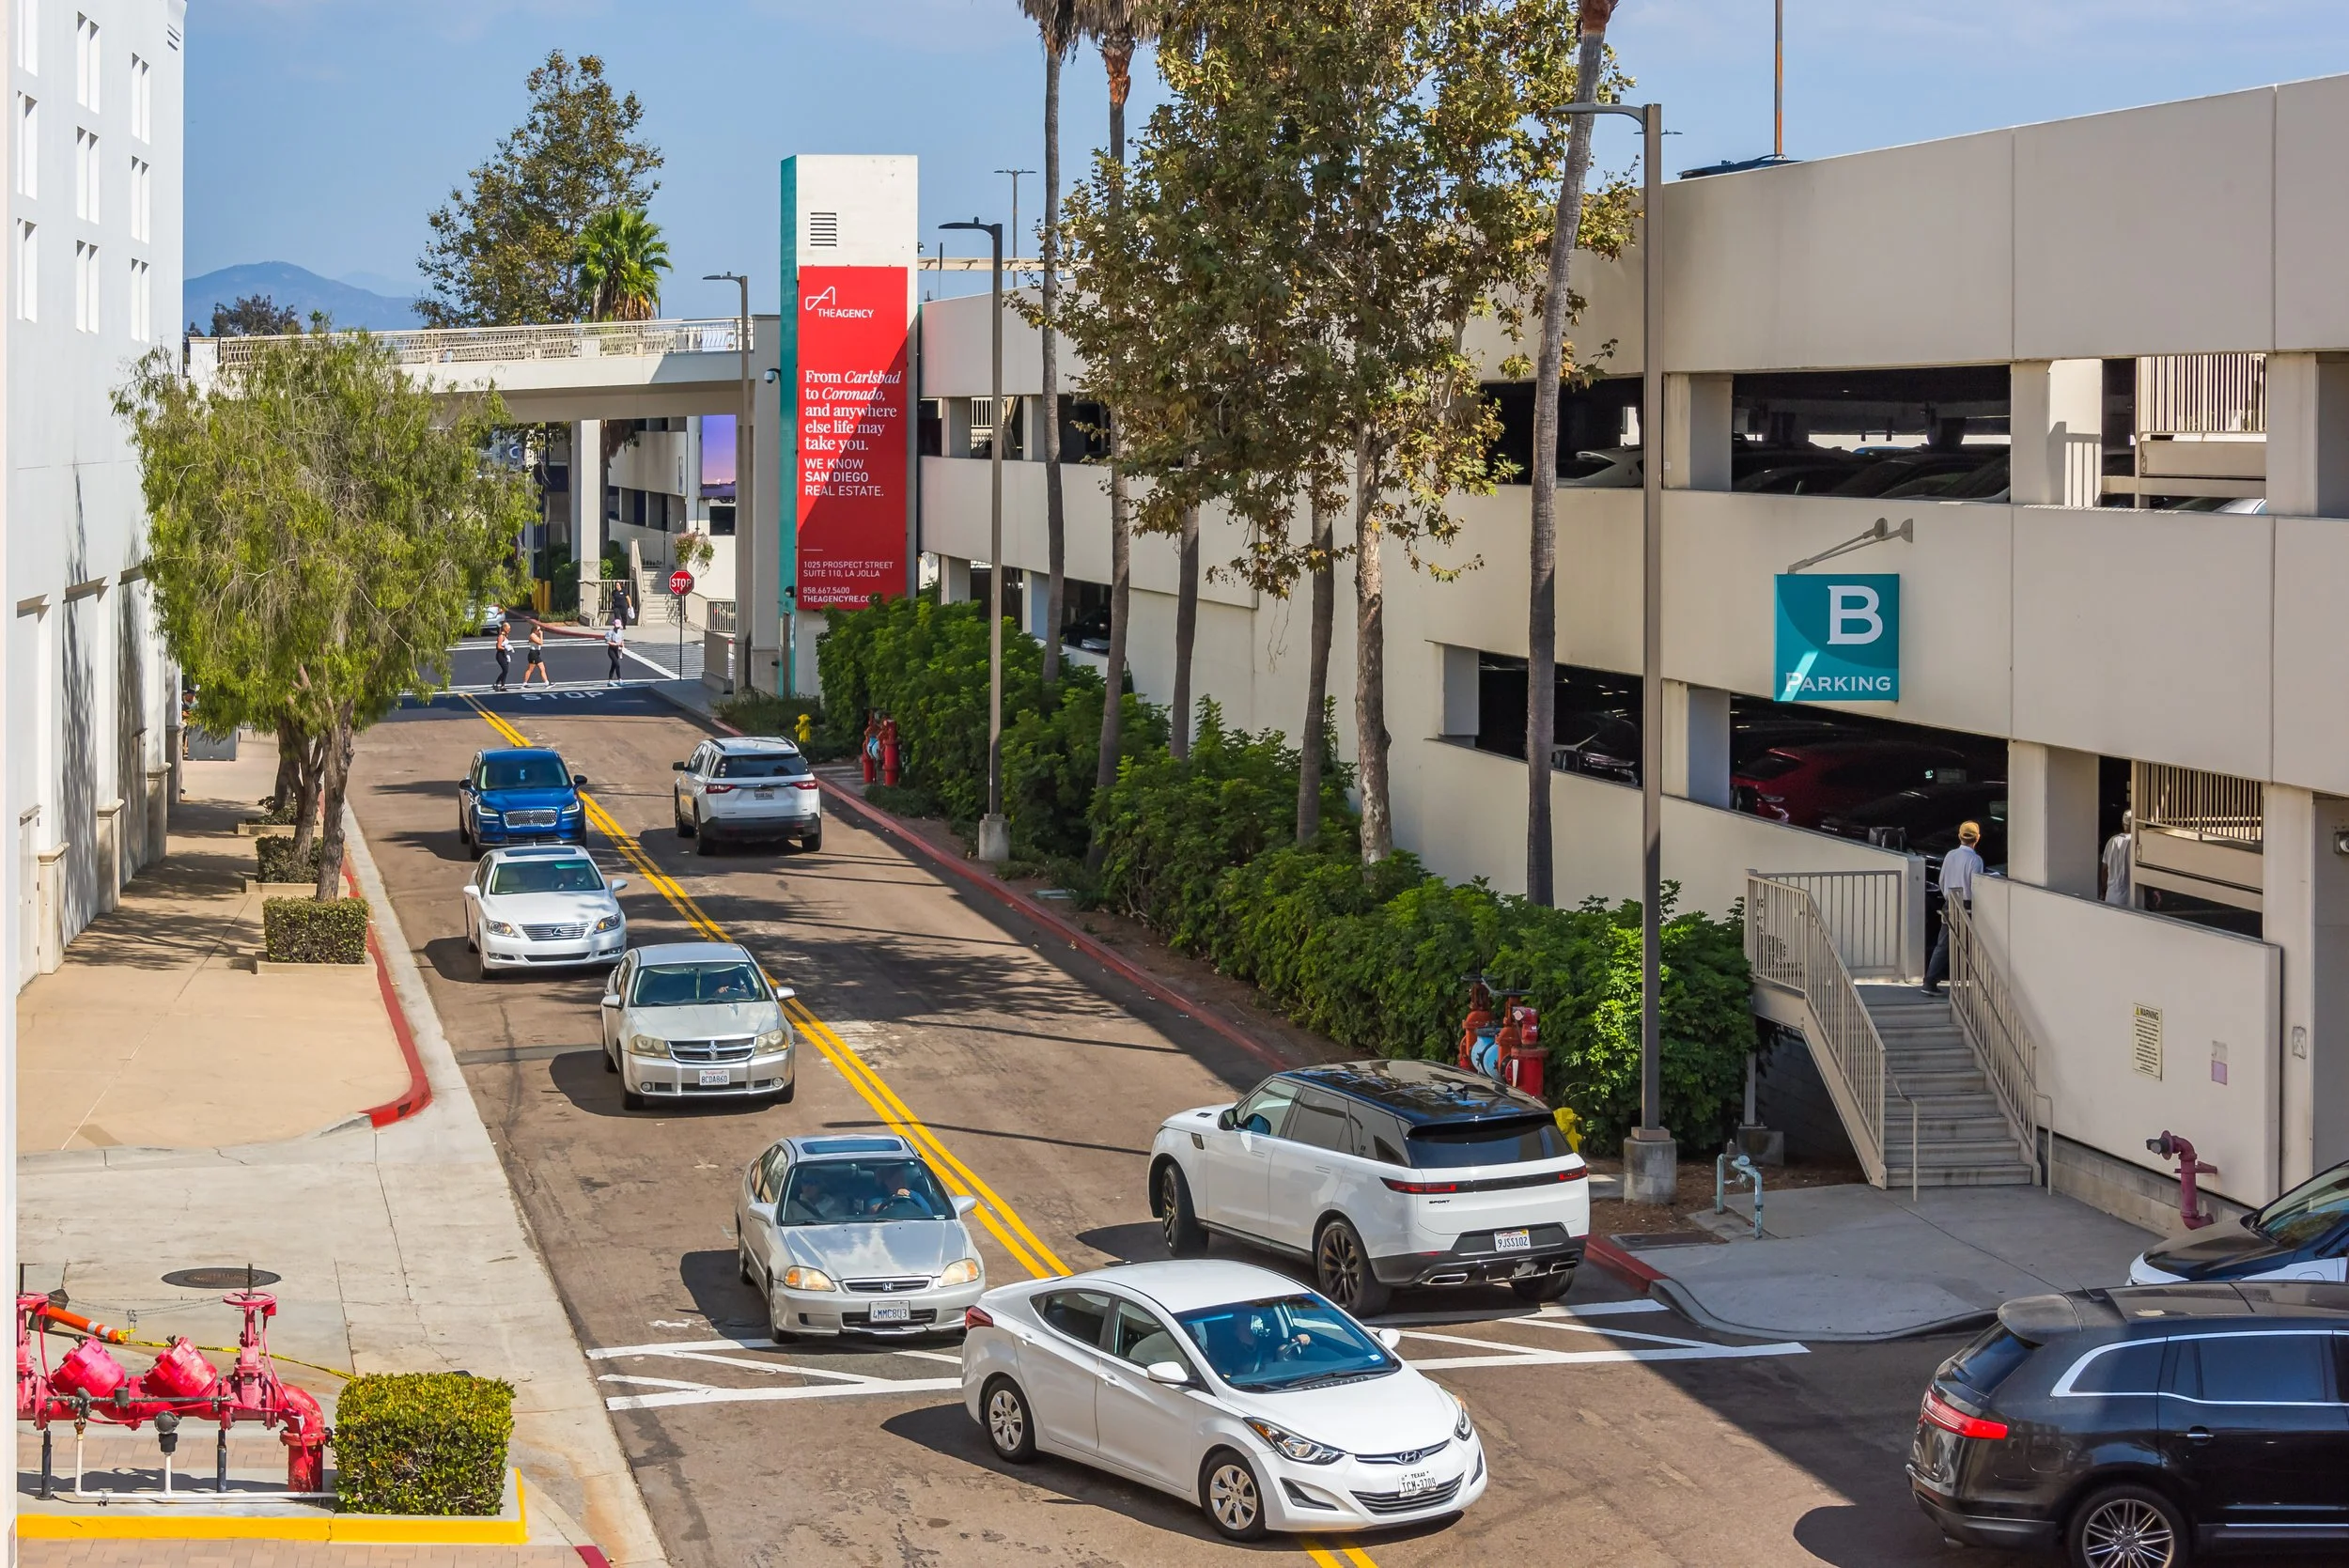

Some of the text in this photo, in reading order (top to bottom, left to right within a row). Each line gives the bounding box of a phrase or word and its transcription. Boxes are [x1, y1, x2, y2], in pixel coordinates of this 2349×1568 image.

[805, 369, 902, 384] From Carlsbad
[805, 387, 886, 402] to Coronado,
[805, 404, 897, 418] and anywhere
[805, 420, 885, 436] else life may
[805, 436, 869, 453] take you.
[804, 458, 863, 469] WE KNOW
[805, 472, 869, 483] SAN DIEGO
[805, 485, 884, 496] REAL ESTATE.
[803, 569, 826, 578] SUITE
[829, 569, 843, 578] 110,
[857, 569, 880, 578] JOLLA
[671, 578, 692, 588] STOP
[802, 595, 870, 603] THEAGENCYRE.CO
[1827, 585, 1883, 644] B
[1785, 672, 1891, 692] PARKING
[521, 691, 604, 701] STOP
[2140, 1007, 2159, 1021] WARNING
